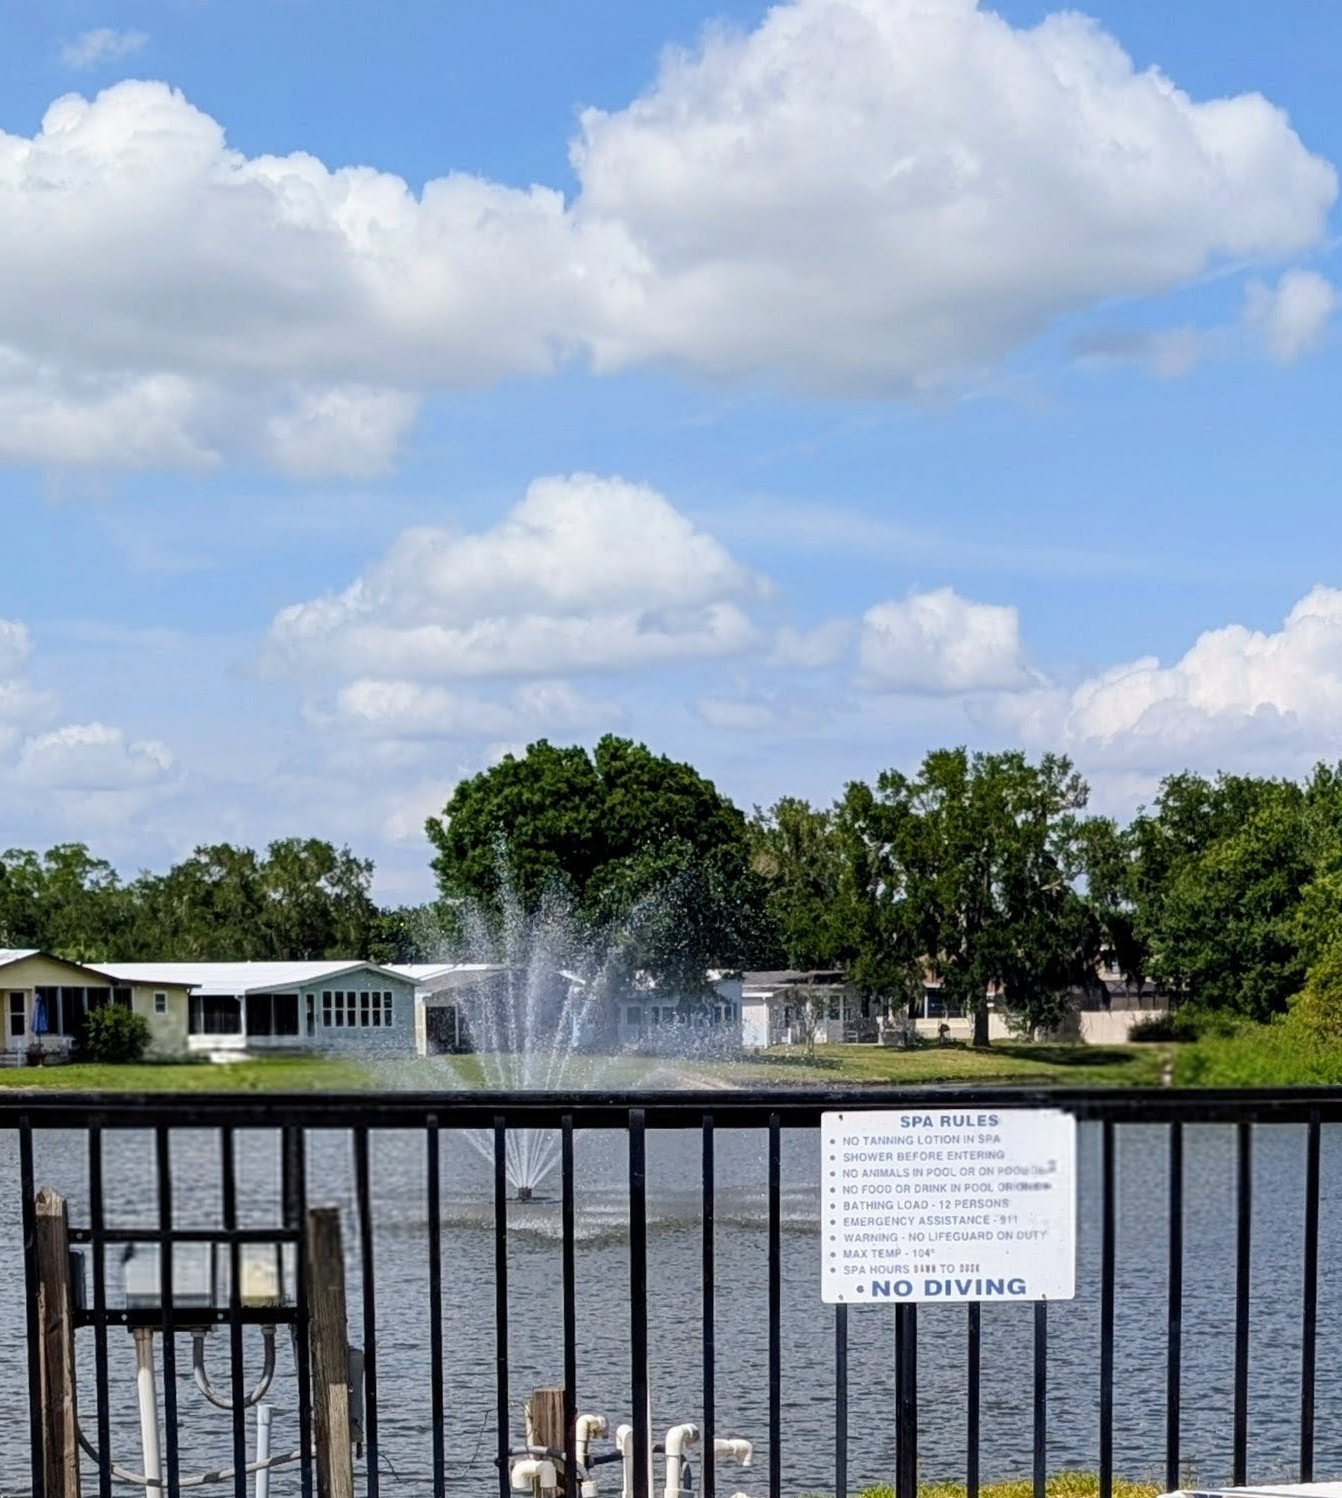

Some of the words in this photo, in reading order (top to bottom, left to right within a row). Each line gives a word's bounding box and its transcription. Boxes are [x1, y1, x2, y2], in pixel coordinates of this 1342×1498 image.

[900, 1115, 933, 1128] SPA
[940, 1114, 999, 1127] RULES
[843, 1136, 859, 1145] NO
[863, 1136, 914, 1145] TANNING
[918, 1135, 960, 1145] LOTION
[963, 1135, 974, 1143] IN
[978, 1134, 1001, 1143] SPA
[843, 1152, 893, 1162] SHOWER
[897, 1151, 943, 1161] BEFORE
[947, 1150, 1005, 1160] ENTERING
[842, 1169, 858, 1178] NO
[861, 1168, 910, 1178] ANIMALS
[913, 1168, 923, 1177] IN
[926, 1167, 956, 1177] POOL
[960, 1167, 975, 1176] OR
[978, 1166, 994, 1176] ON
[842, 1185, 858, 1194] NO
[861, 1184, 892, 1194] FOOD
[895, 1184, 911, 1193] OR
[914, 1184, 947, 1193] DRINK
[950, 1183, 961, 1192] IN
[964, 1183, 994, 1192] POOL
[997, 1182, 1014, 1192] OR
[843, 1200, 894, 1211] BATHING
[897, 1200, 929, 1210] LOAD
[939, 1200, 951, 1209] 12
[955, 1198, 1009, 1209] PERSONS
[843, 1216, 915, 1227] EMERGENCY
[918, 1215, 990, 1225] ASSISTANCE
[1000, 1215, 1018, 1224] 911
[843, 1232, 898, 1242] WARNING
[908, 1232, 925, 1241] NO
[928, 1231, 993, 1241] LIFEGUARD
[997, 1231, 1013, 1240] ON
[1016, 1230, 1047, 1240] DUTY
[843, 1249, 868, 1258] MAX
[871, 1248, 901, 1258] TEMP
[843, 1265, 866, 1275] SPA
[870, 1264, 910, 1274] HOURS
[940, 1264, 955, 1273] TO
[872, 1280, 913, 1297] NO
[924, 1278, 1027, 1296] DIVING
